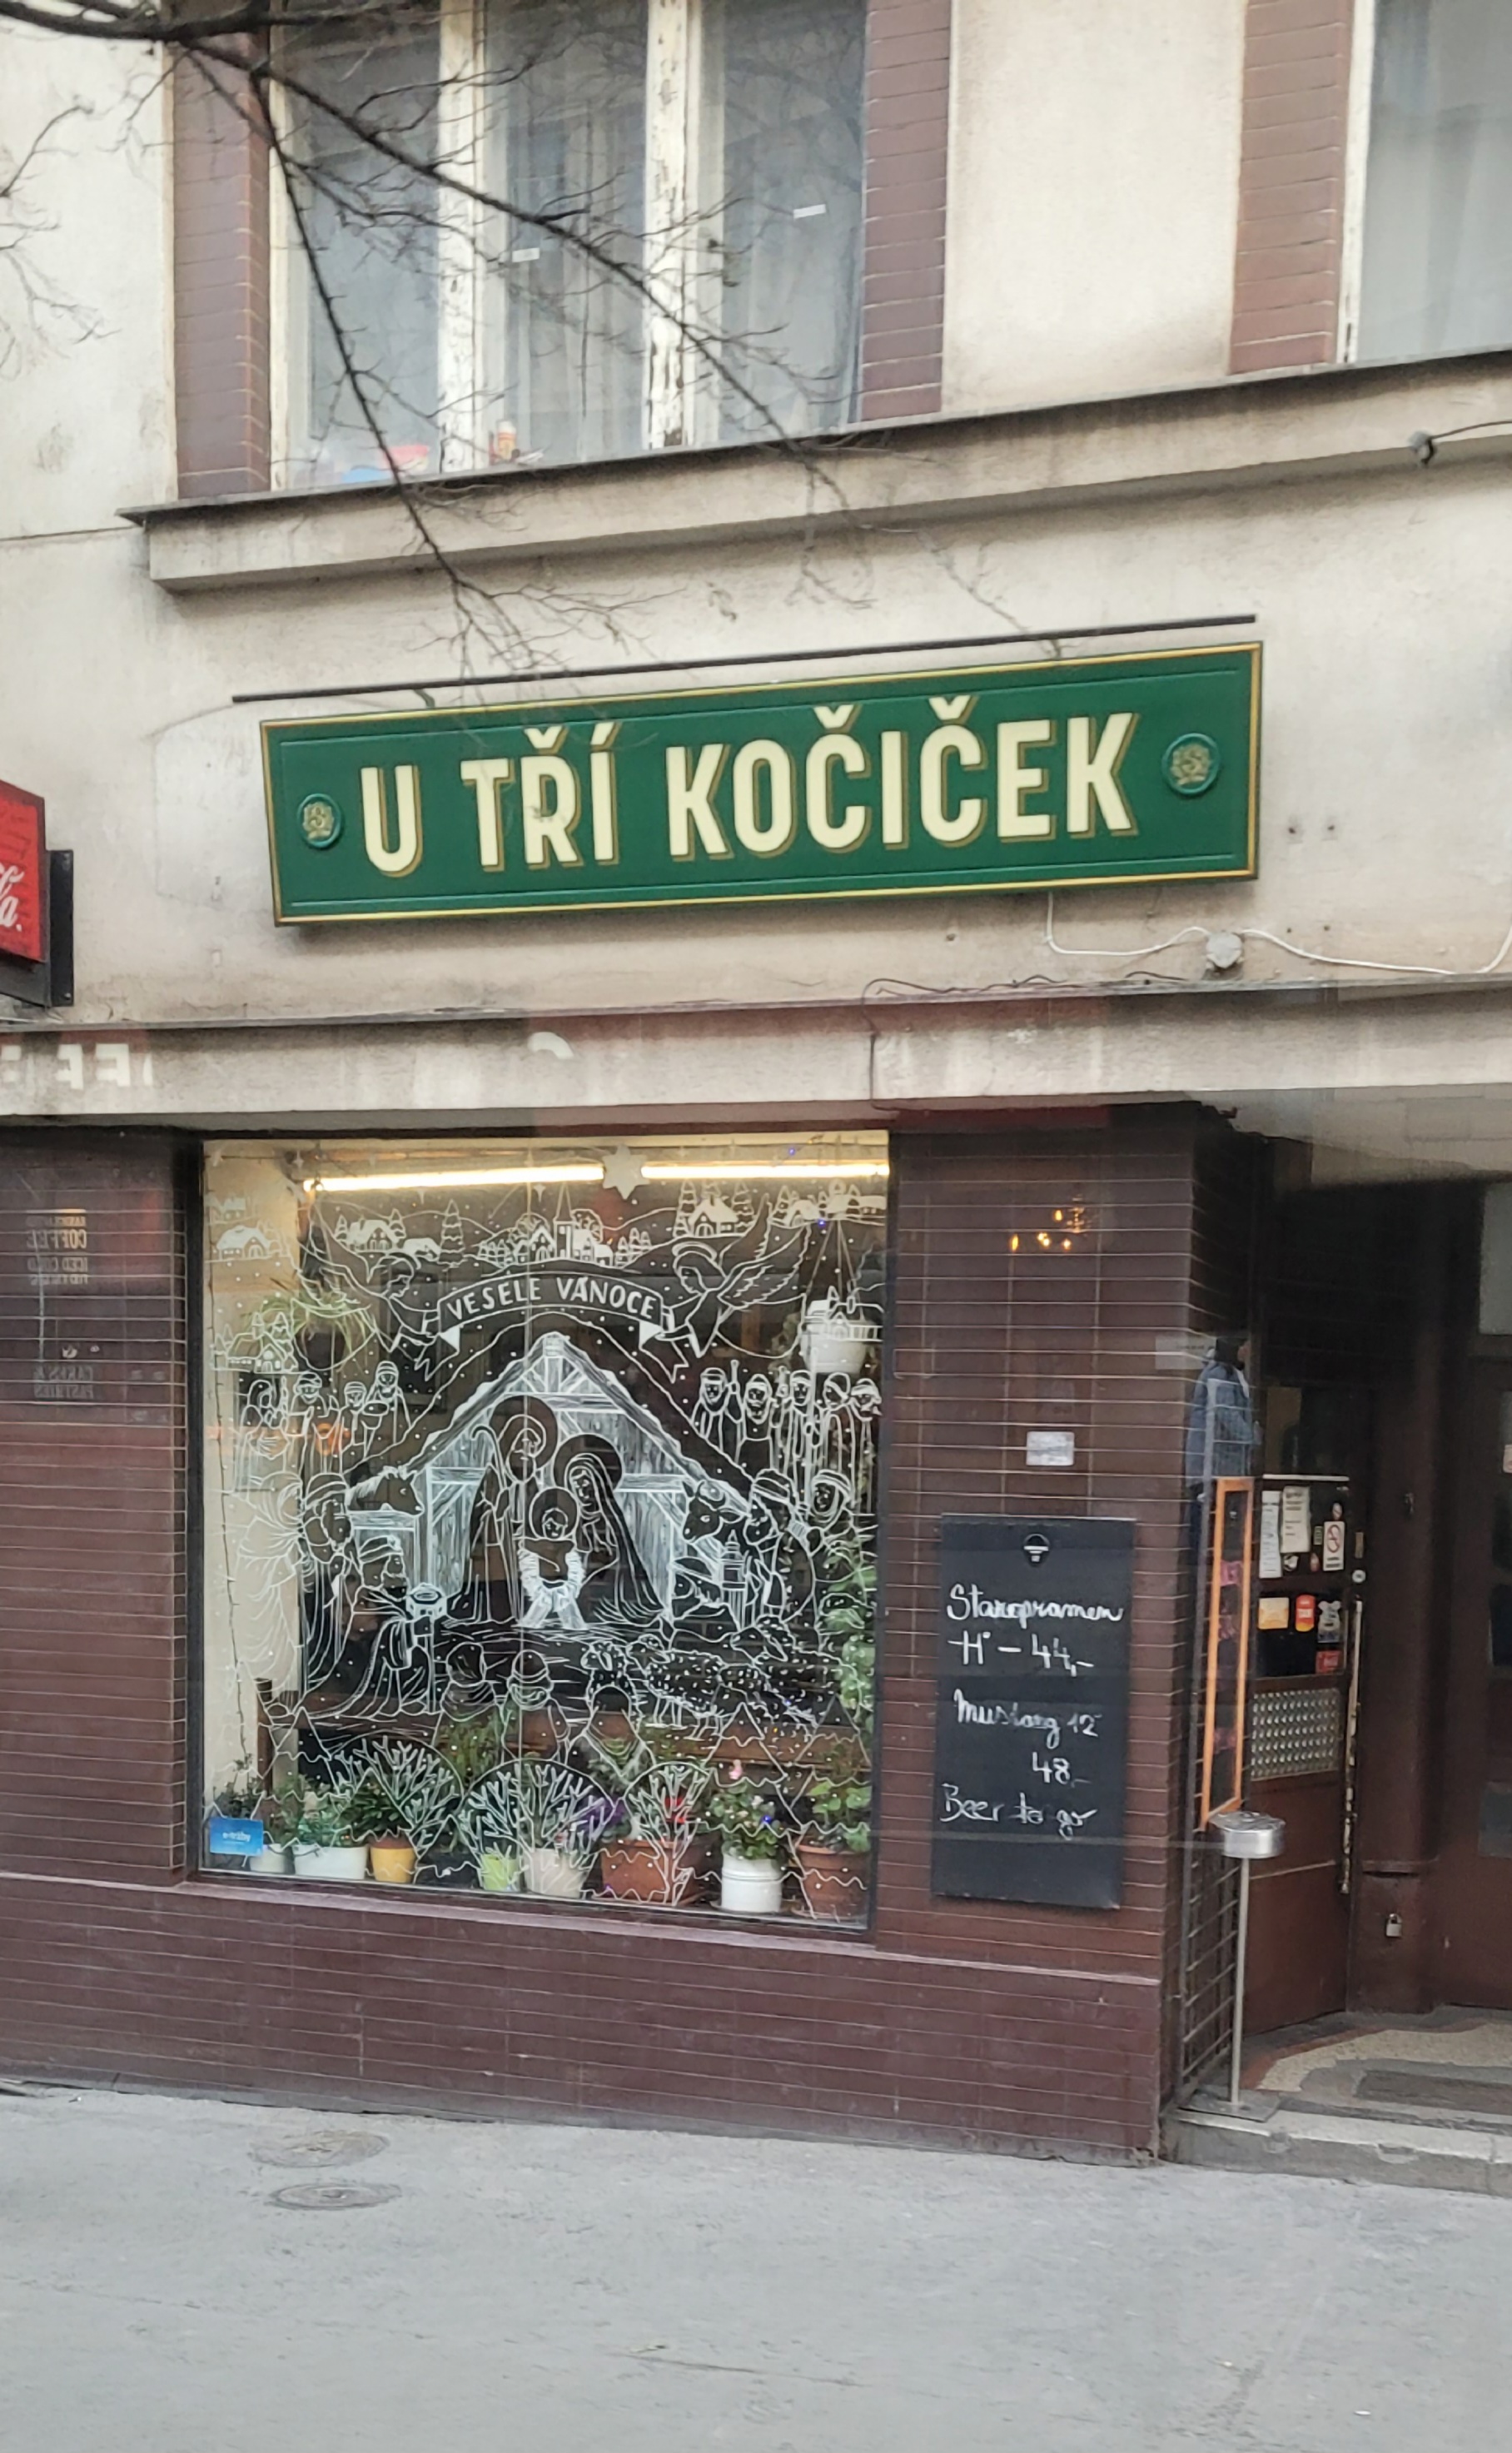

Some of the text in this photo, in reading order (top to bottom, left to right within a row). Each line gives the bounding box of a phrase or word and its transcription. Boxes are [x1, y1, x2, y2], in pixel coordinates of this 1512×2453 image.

[361, 694, 1140, 878] U TŘÍ KOČIČEK
[947, 1583, 1123, 1630] Staropramen
[940, 1783, 1005, 1822] Beer
[1009, 1792, 1043, 1824] to
